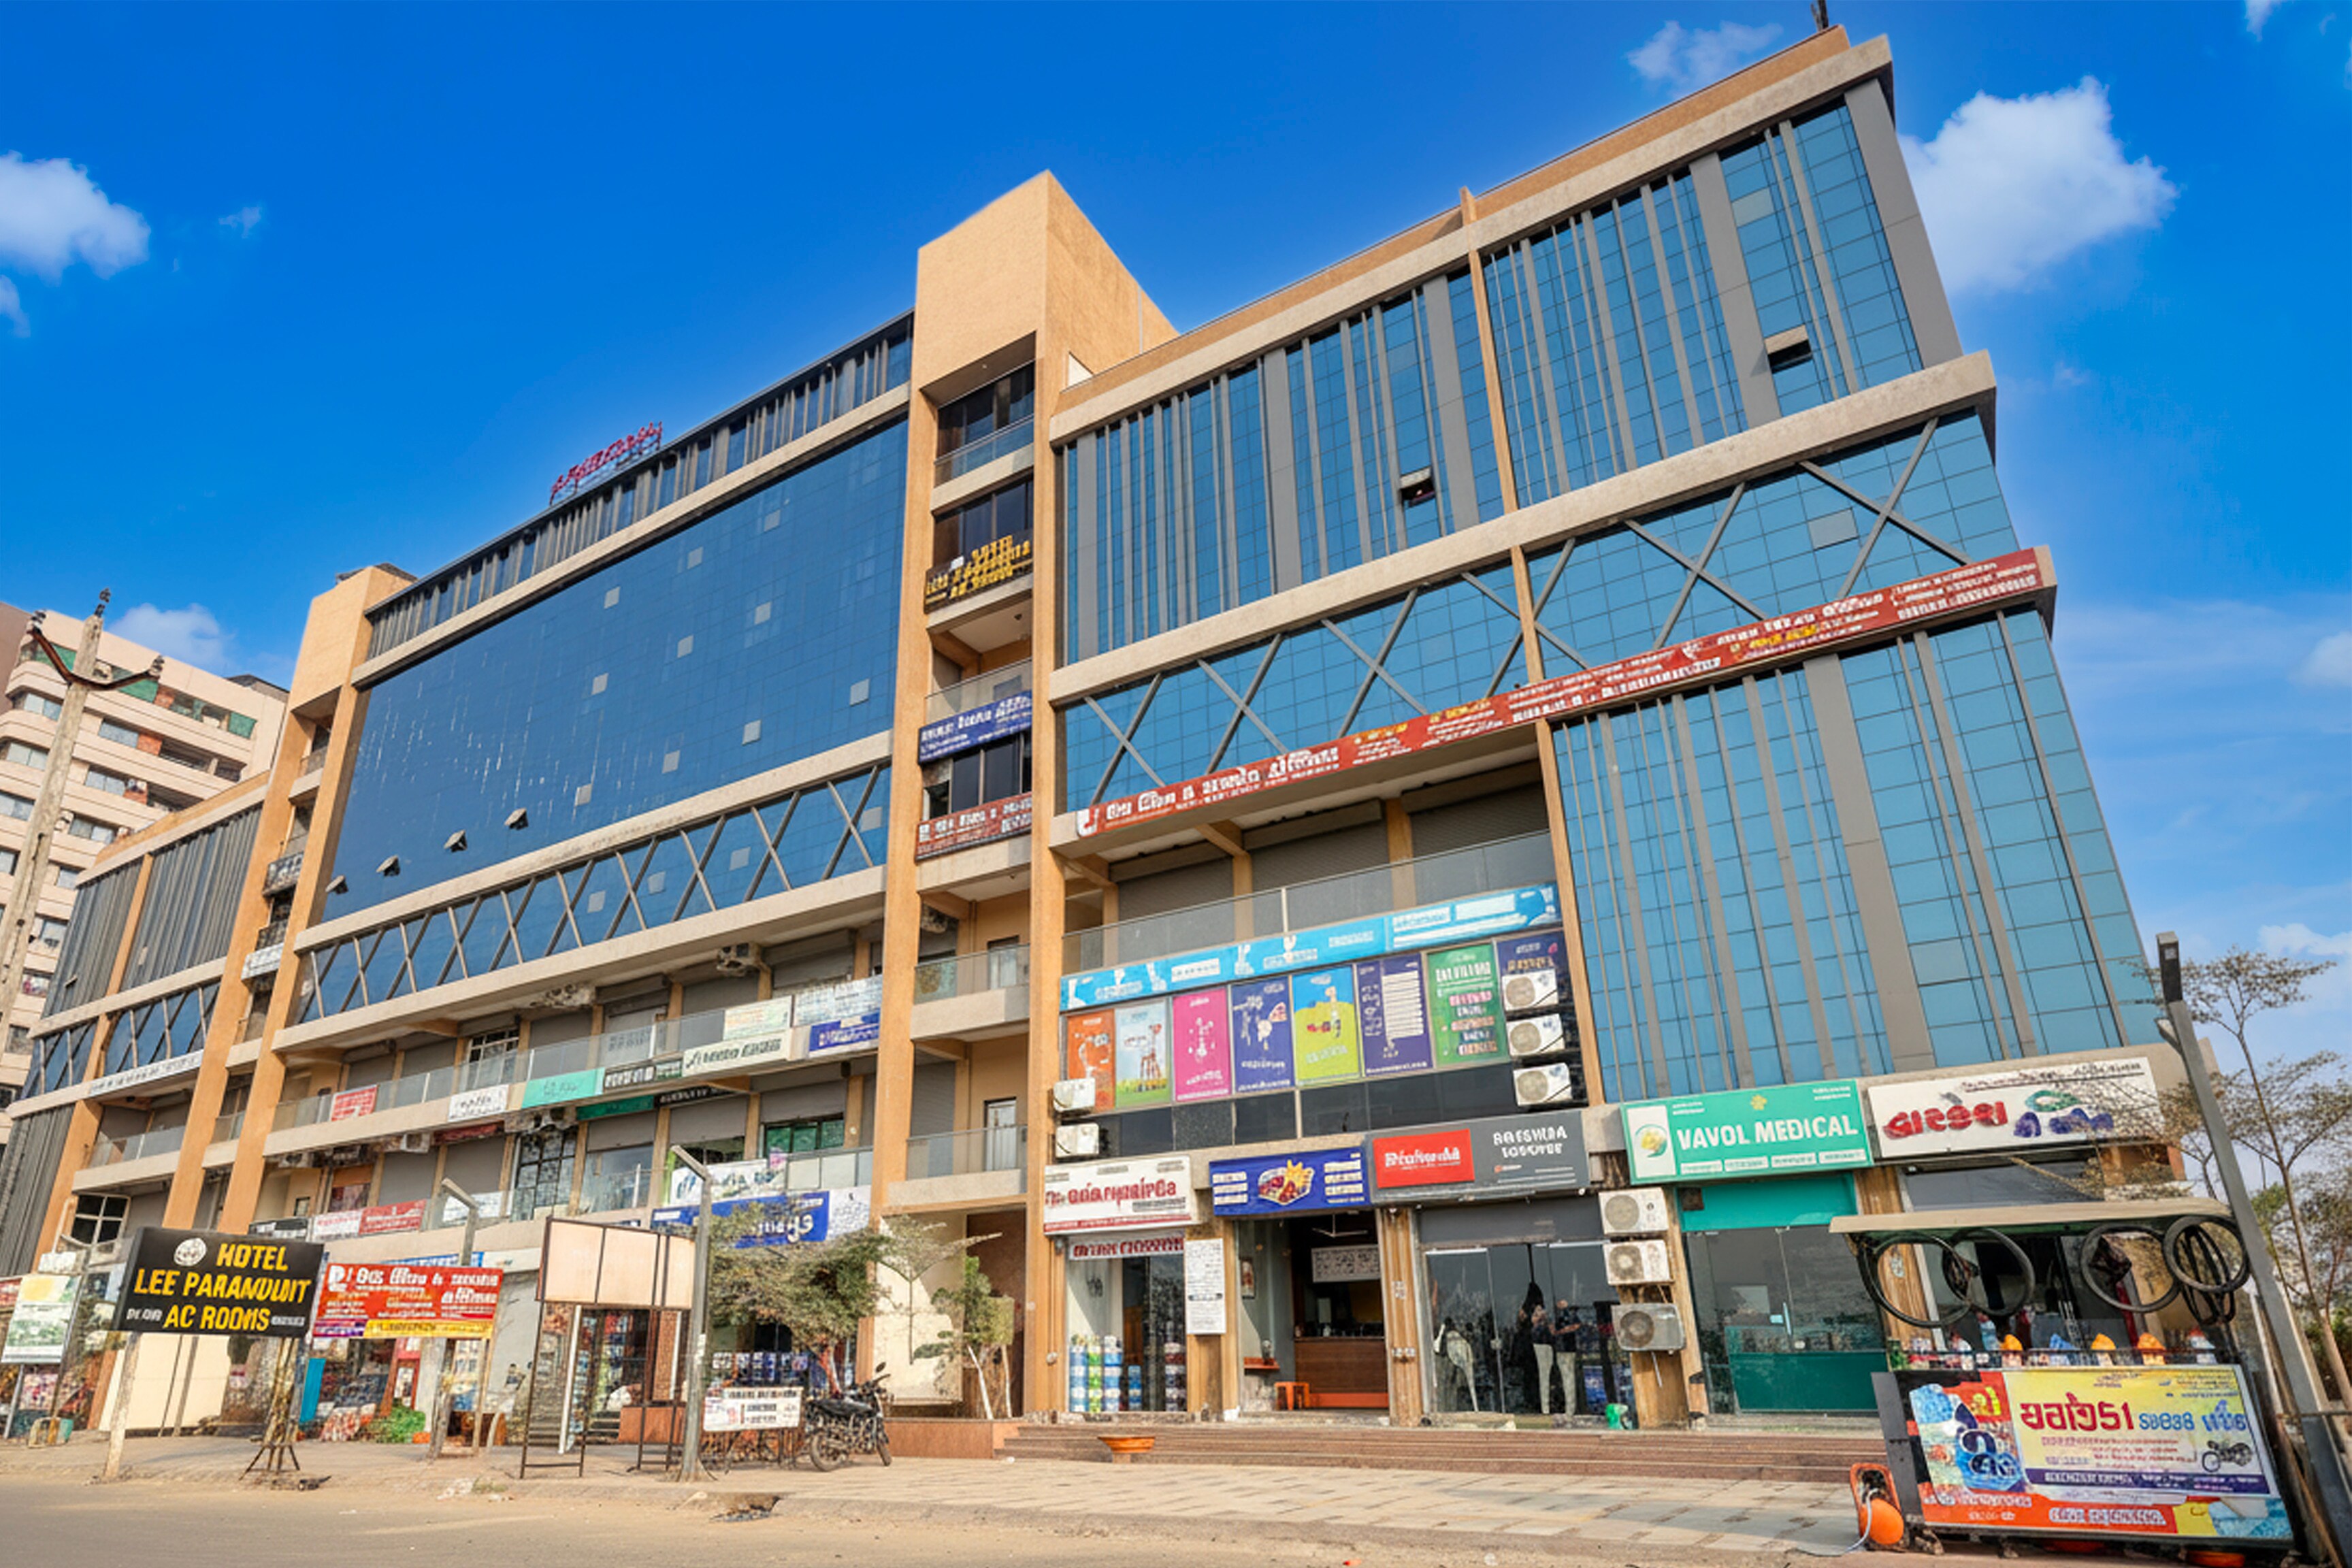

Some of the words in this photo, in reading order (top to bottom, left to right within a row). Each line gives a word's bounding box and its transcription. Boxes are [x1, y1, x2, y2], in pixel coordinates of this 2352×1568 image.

[1676, 1124, 1750, 1151] VAVOL
[1754, 1115, 1859, 1144] MEDICAL
[216, 1243, 289, 1271] HOTEL
[133, 1269, 180, 1296] LEE
[163, 1304, 197, 1329] AC
[199, 1305, 272, 1331] ROOMS
